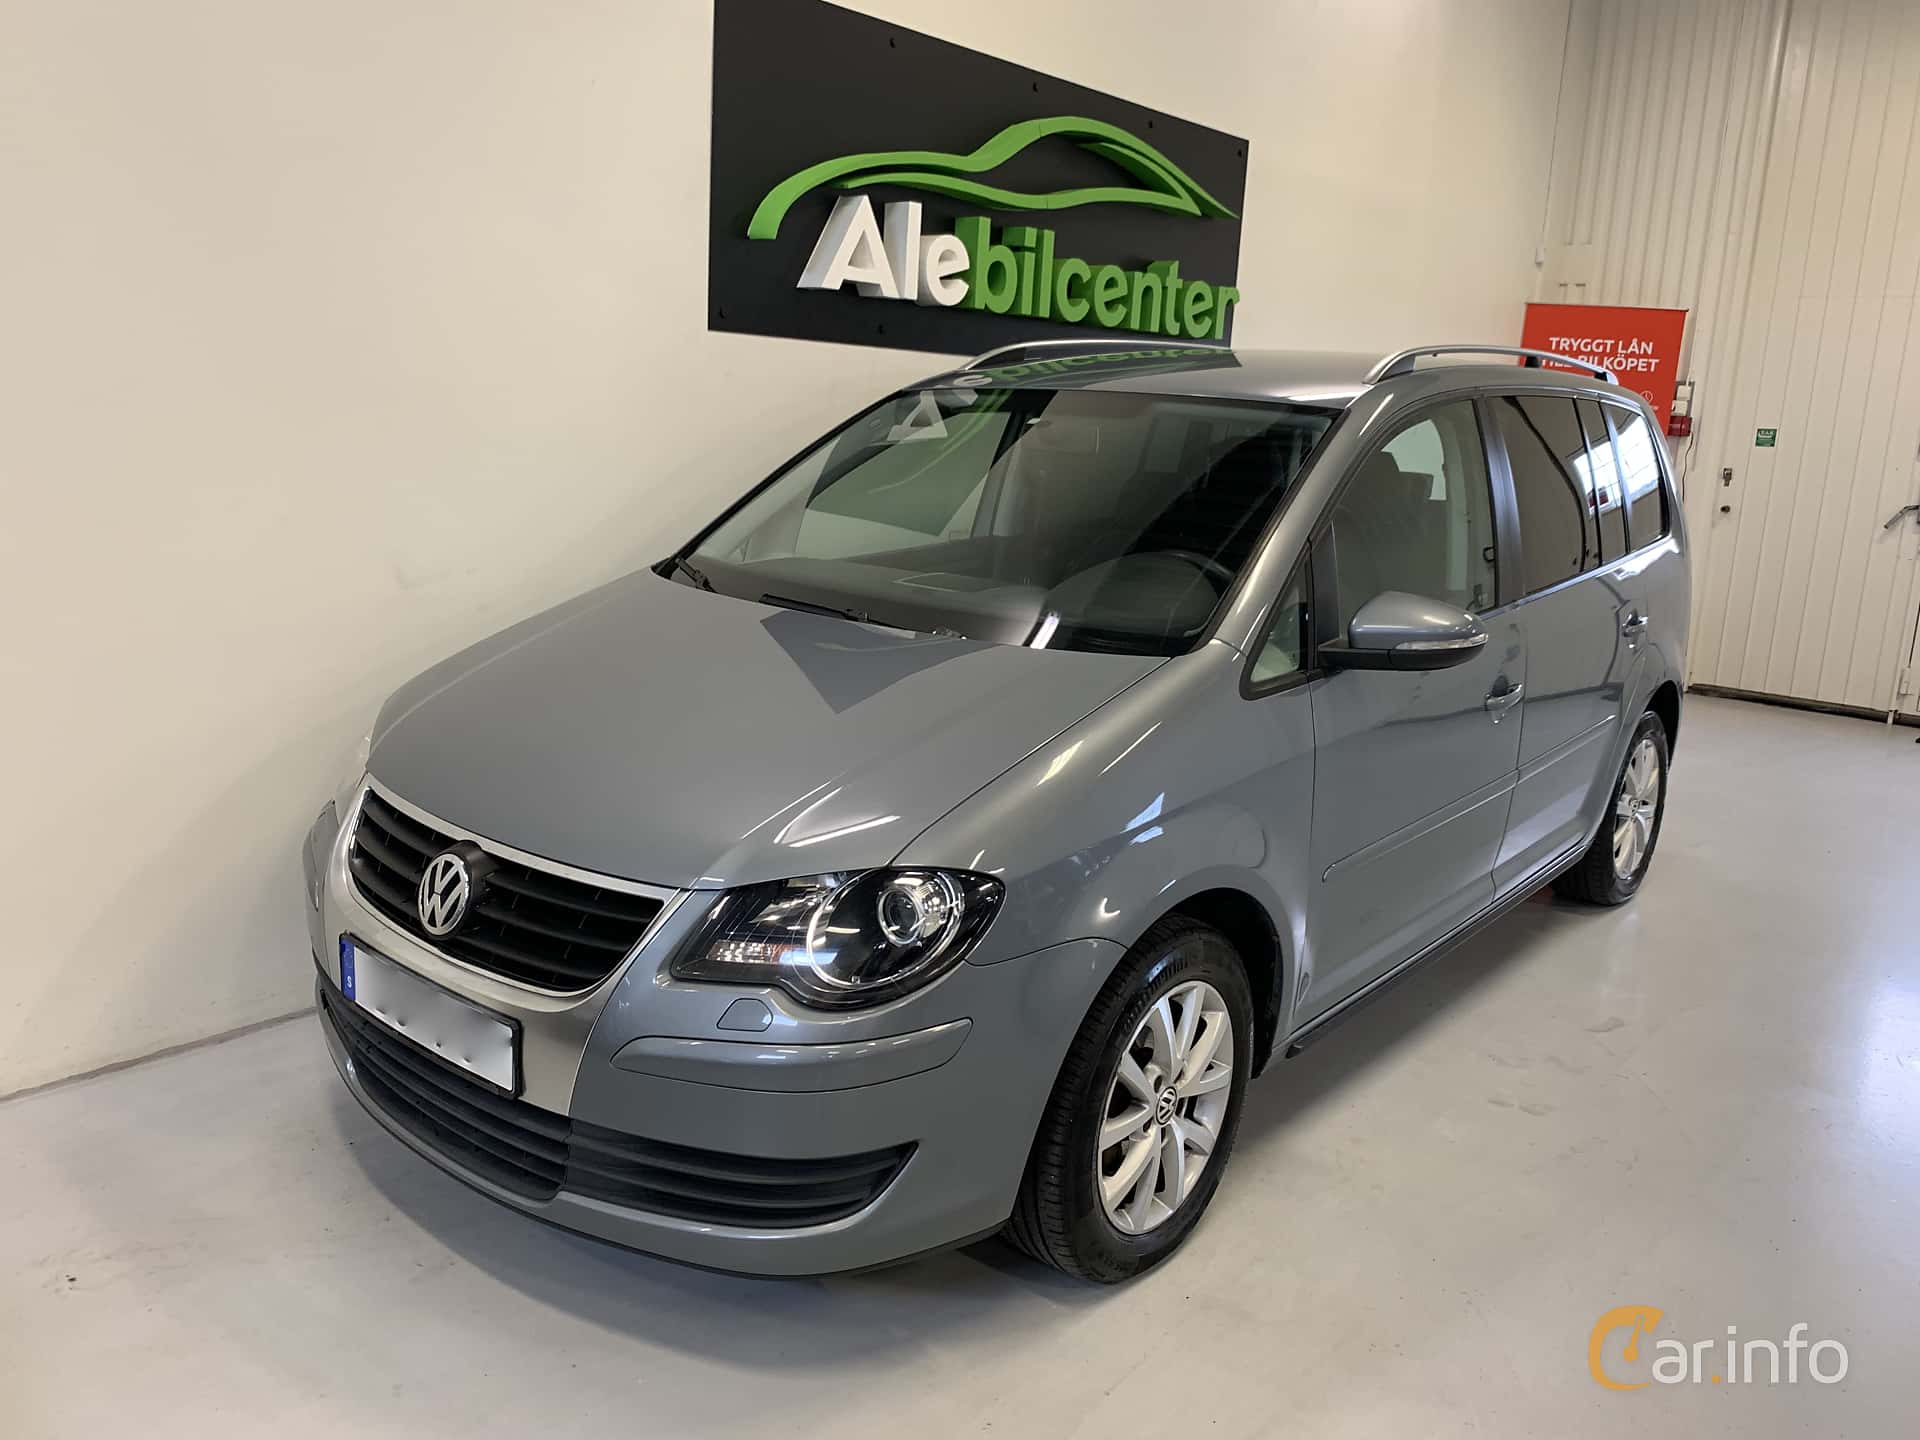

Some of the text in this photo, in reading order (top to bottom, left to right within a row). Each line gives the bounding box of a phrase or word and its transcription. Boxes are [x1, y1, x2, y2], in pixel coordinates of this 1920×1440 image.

[797, 194, 1240, 340] Alebilcenter
[1549, 337, 1653, 354] TRYGGT LÅN
[346, 975, 352, 988] S
